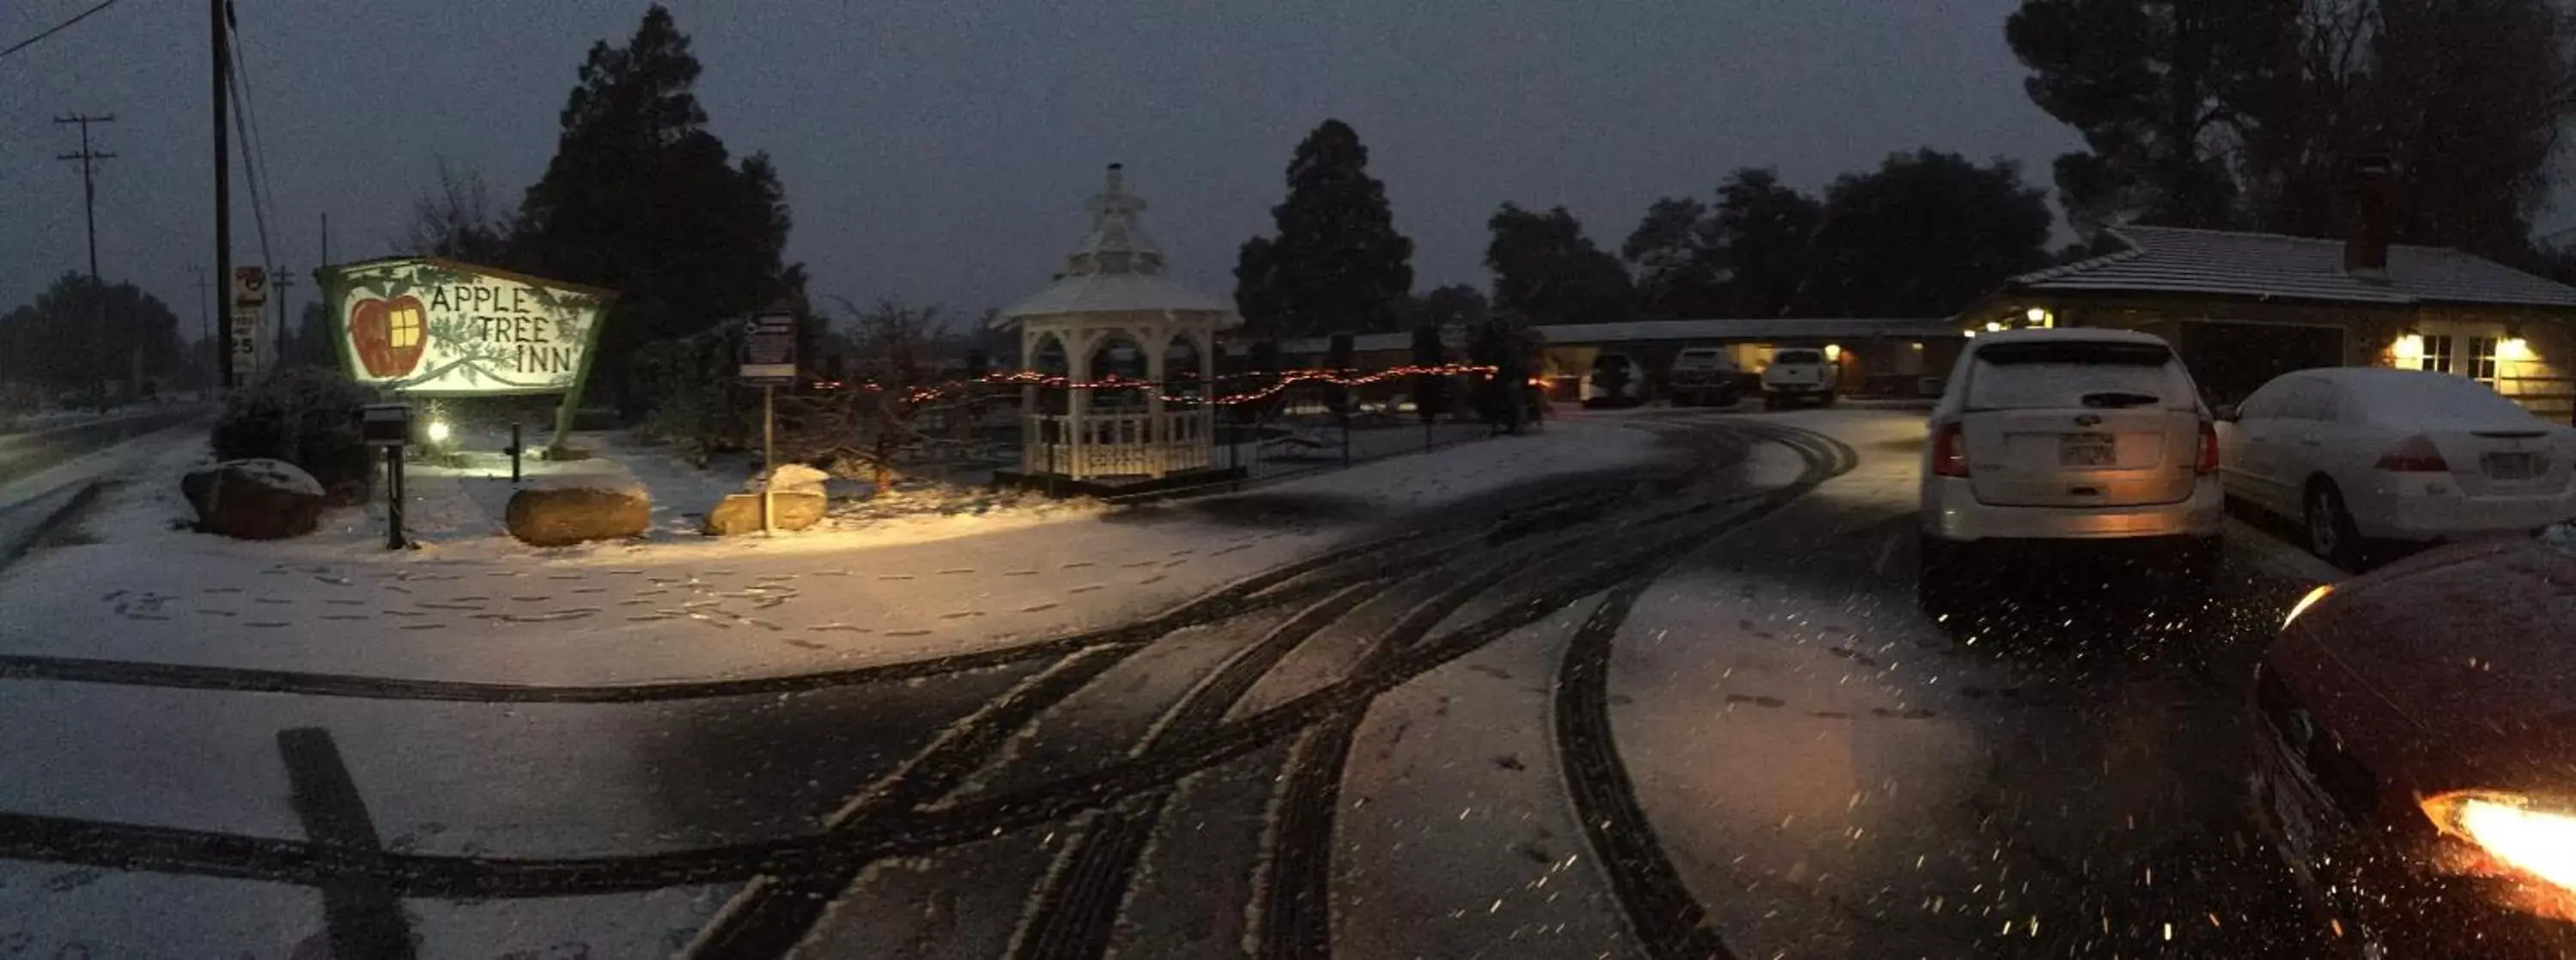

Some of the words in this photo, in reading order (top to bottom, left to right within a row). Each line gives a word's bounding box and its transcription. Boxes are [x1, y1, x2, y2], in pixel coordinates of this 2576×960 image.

[430, 286, 534, 314] APPLE
[477, 316, 550, 343] TREE
[516, 344, 573, 374] INN
